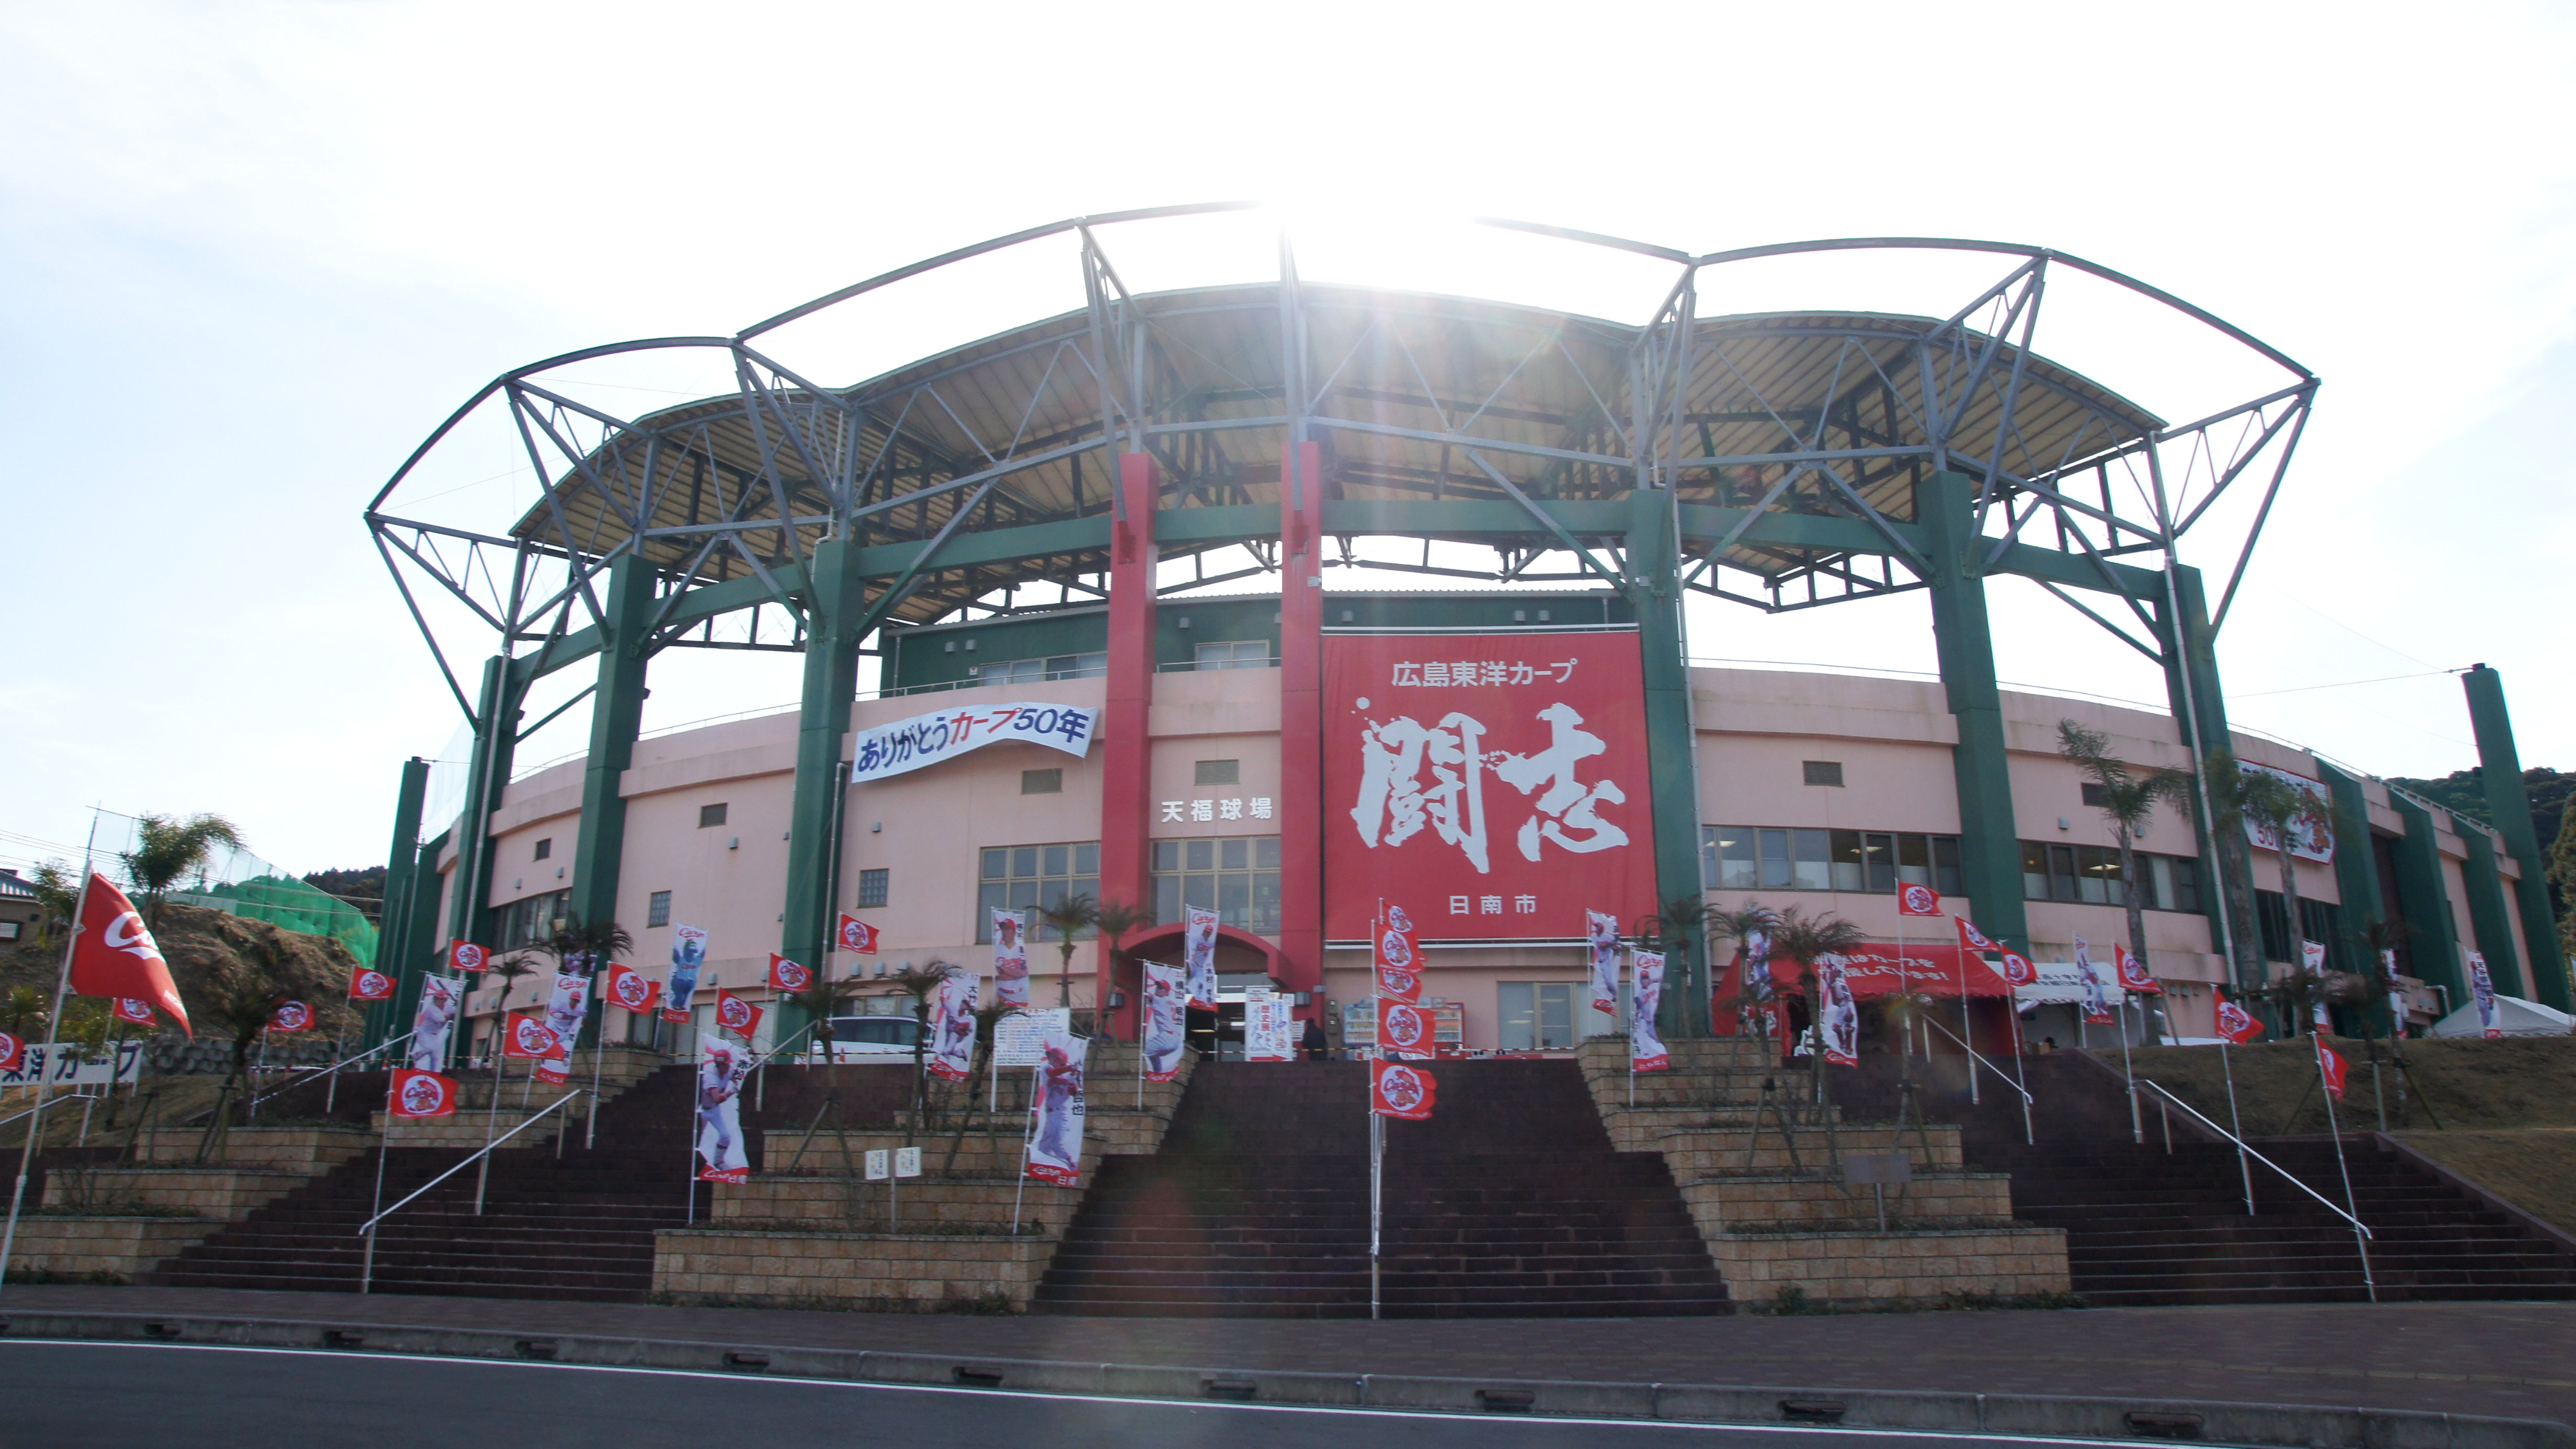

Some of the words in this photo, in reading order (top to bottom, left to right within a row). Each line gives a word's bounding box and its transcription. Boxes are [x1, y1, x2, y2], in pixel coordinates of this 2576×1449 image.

[1391, 658, 1578, 688] 広島東洋カープ
[857, 707, 1090, 773] ありがとうカープ50年
[1350, 697, 1630, 874] 闘志
[1160, 797, 1273, 824] 天福球場
[1449, 894, 1537, 915] 日南市
